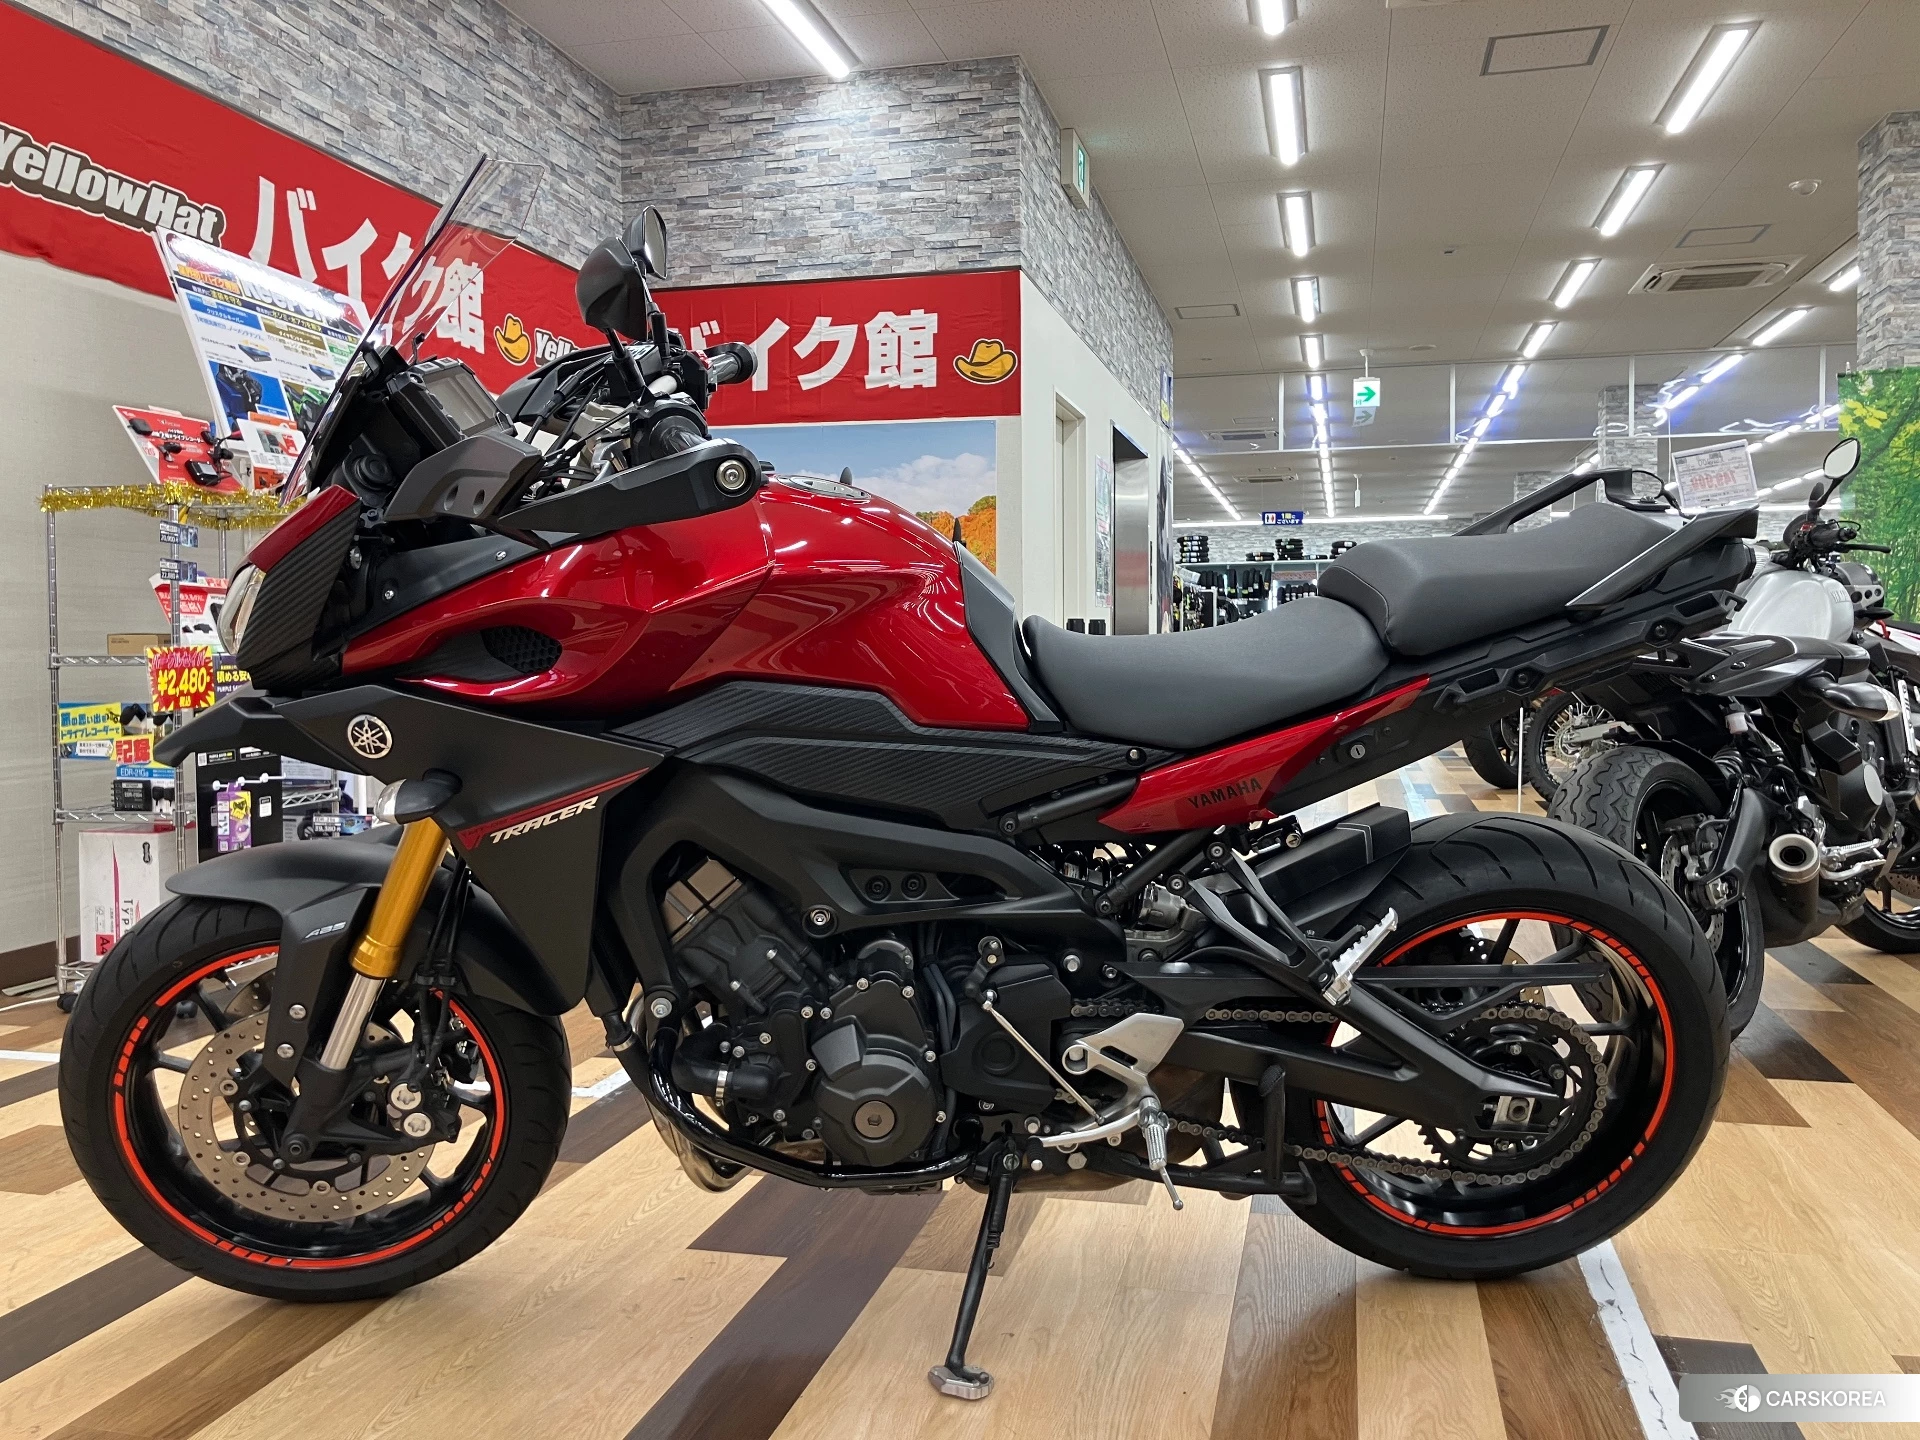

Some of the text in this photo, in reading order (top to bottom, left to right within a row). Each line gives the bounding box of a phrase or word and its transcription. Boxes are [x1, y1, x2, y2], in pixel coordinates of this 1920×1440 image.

[116, 738, 151, 764] 記録
[1188, 777, 1263, 809] YAMAHA
[490, 795, 599, 844] TRACER
[304, 921, 347, 939] ABS
